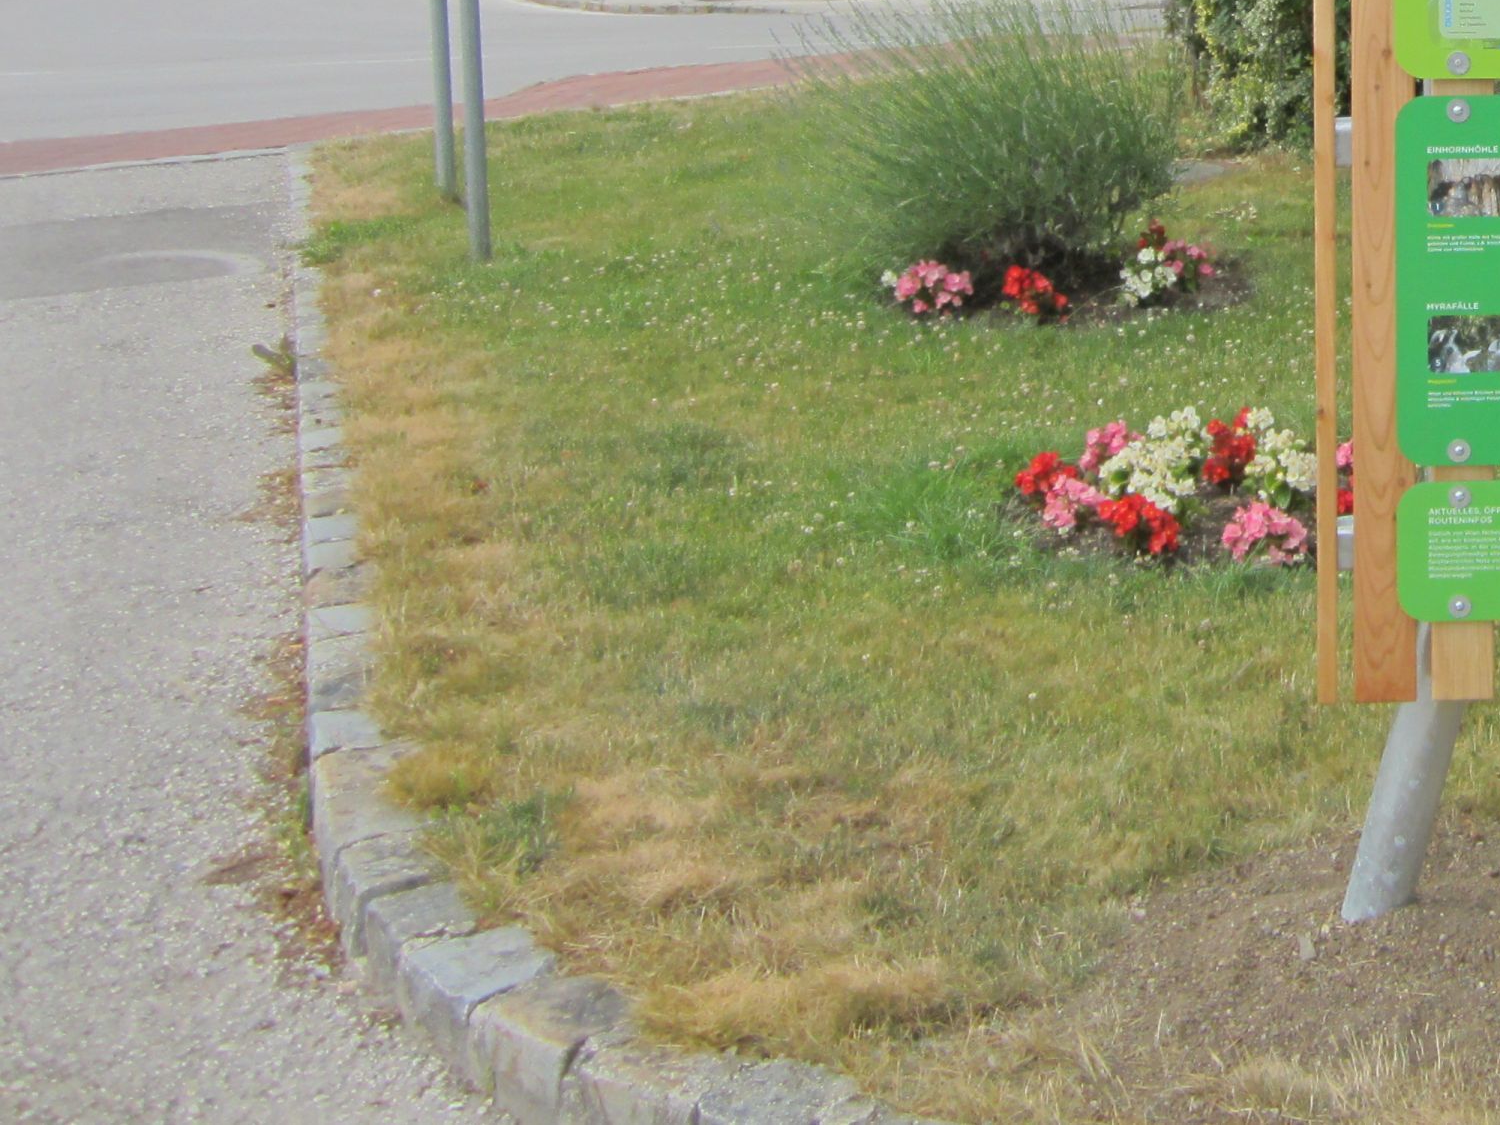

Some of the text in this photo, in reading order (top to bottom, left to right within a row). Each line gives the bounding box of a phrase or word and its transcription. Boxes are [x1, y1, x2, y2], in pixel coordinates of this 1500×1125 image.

[1426, 145, 1499, 154] EINHORNHÖHLE
[1426, 301, 1479, 310] MYRAFÄLLE
[1435, 359, 1441, 367] 5
[1428, 516, 1493, 524] ROUTENINFOS
